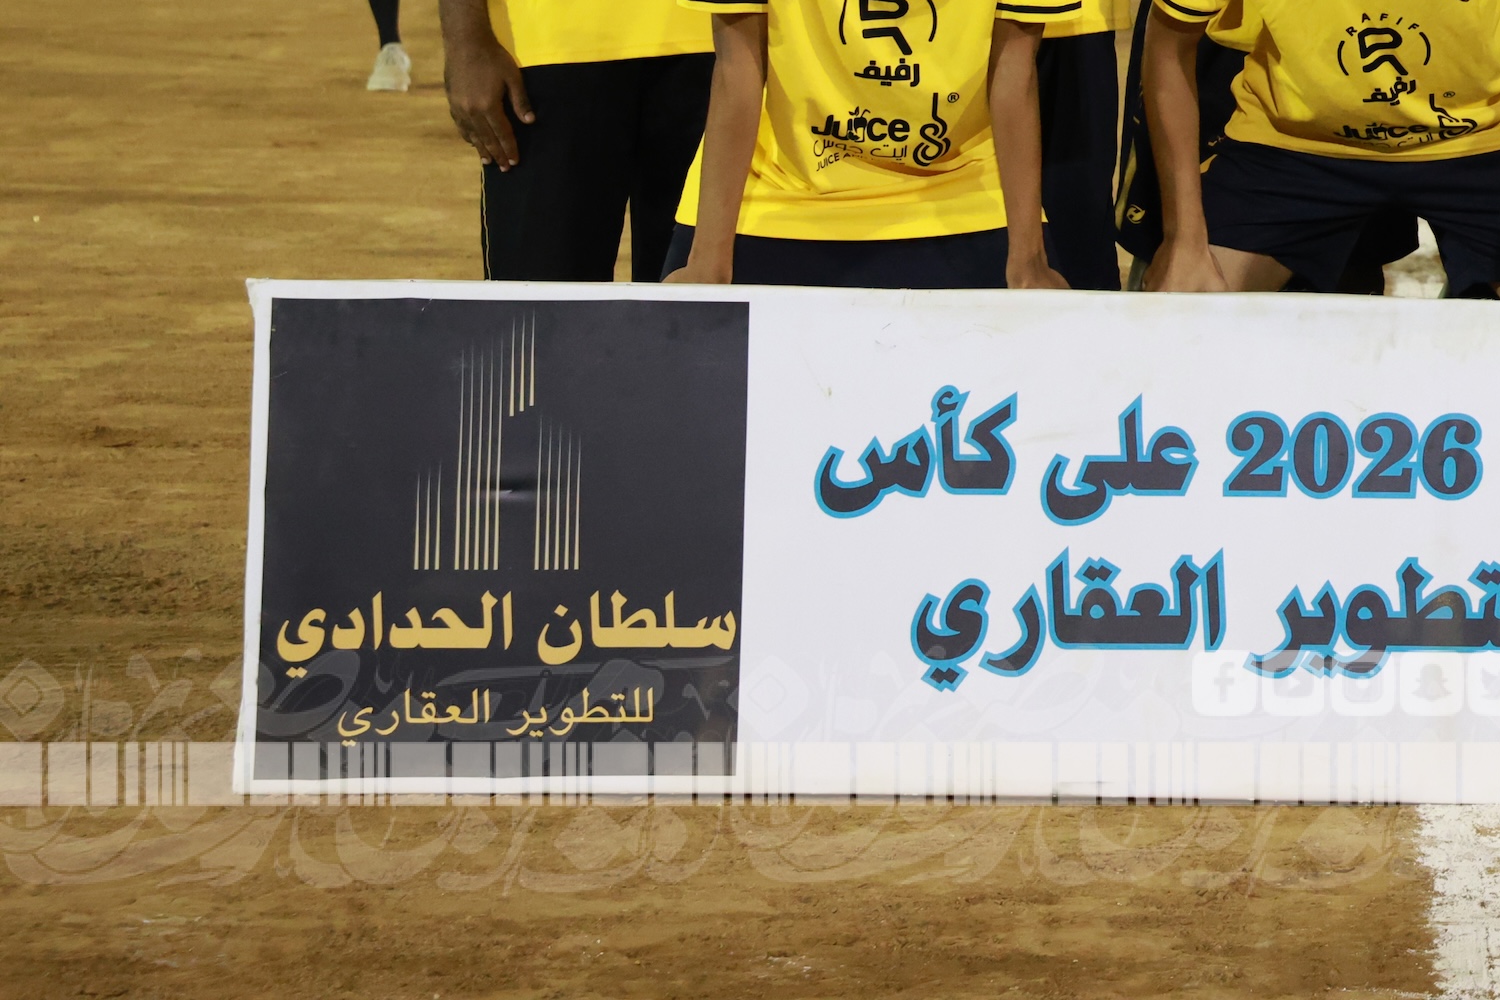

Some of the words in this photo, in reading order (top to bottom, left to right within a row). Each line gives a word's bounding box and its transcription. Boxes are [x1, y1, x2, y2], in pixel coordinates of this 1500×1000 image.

[1345, 12, 1420, 37] RAFIF
[816, 152, 840, 172] JUICE
[814, 384, 1018, 519] كأس
[1040, 393, 1199, 527] على
[1222, 410, 1483, 500] 2026
[276, 589, 513, 678] الحدادي
[537, 589, 737, 666] سلطان
[910, 546, 1225, 692] العقاري
[337, 688, 491, 748] العقاري
[506, 687, 655, 739] للتطوير
